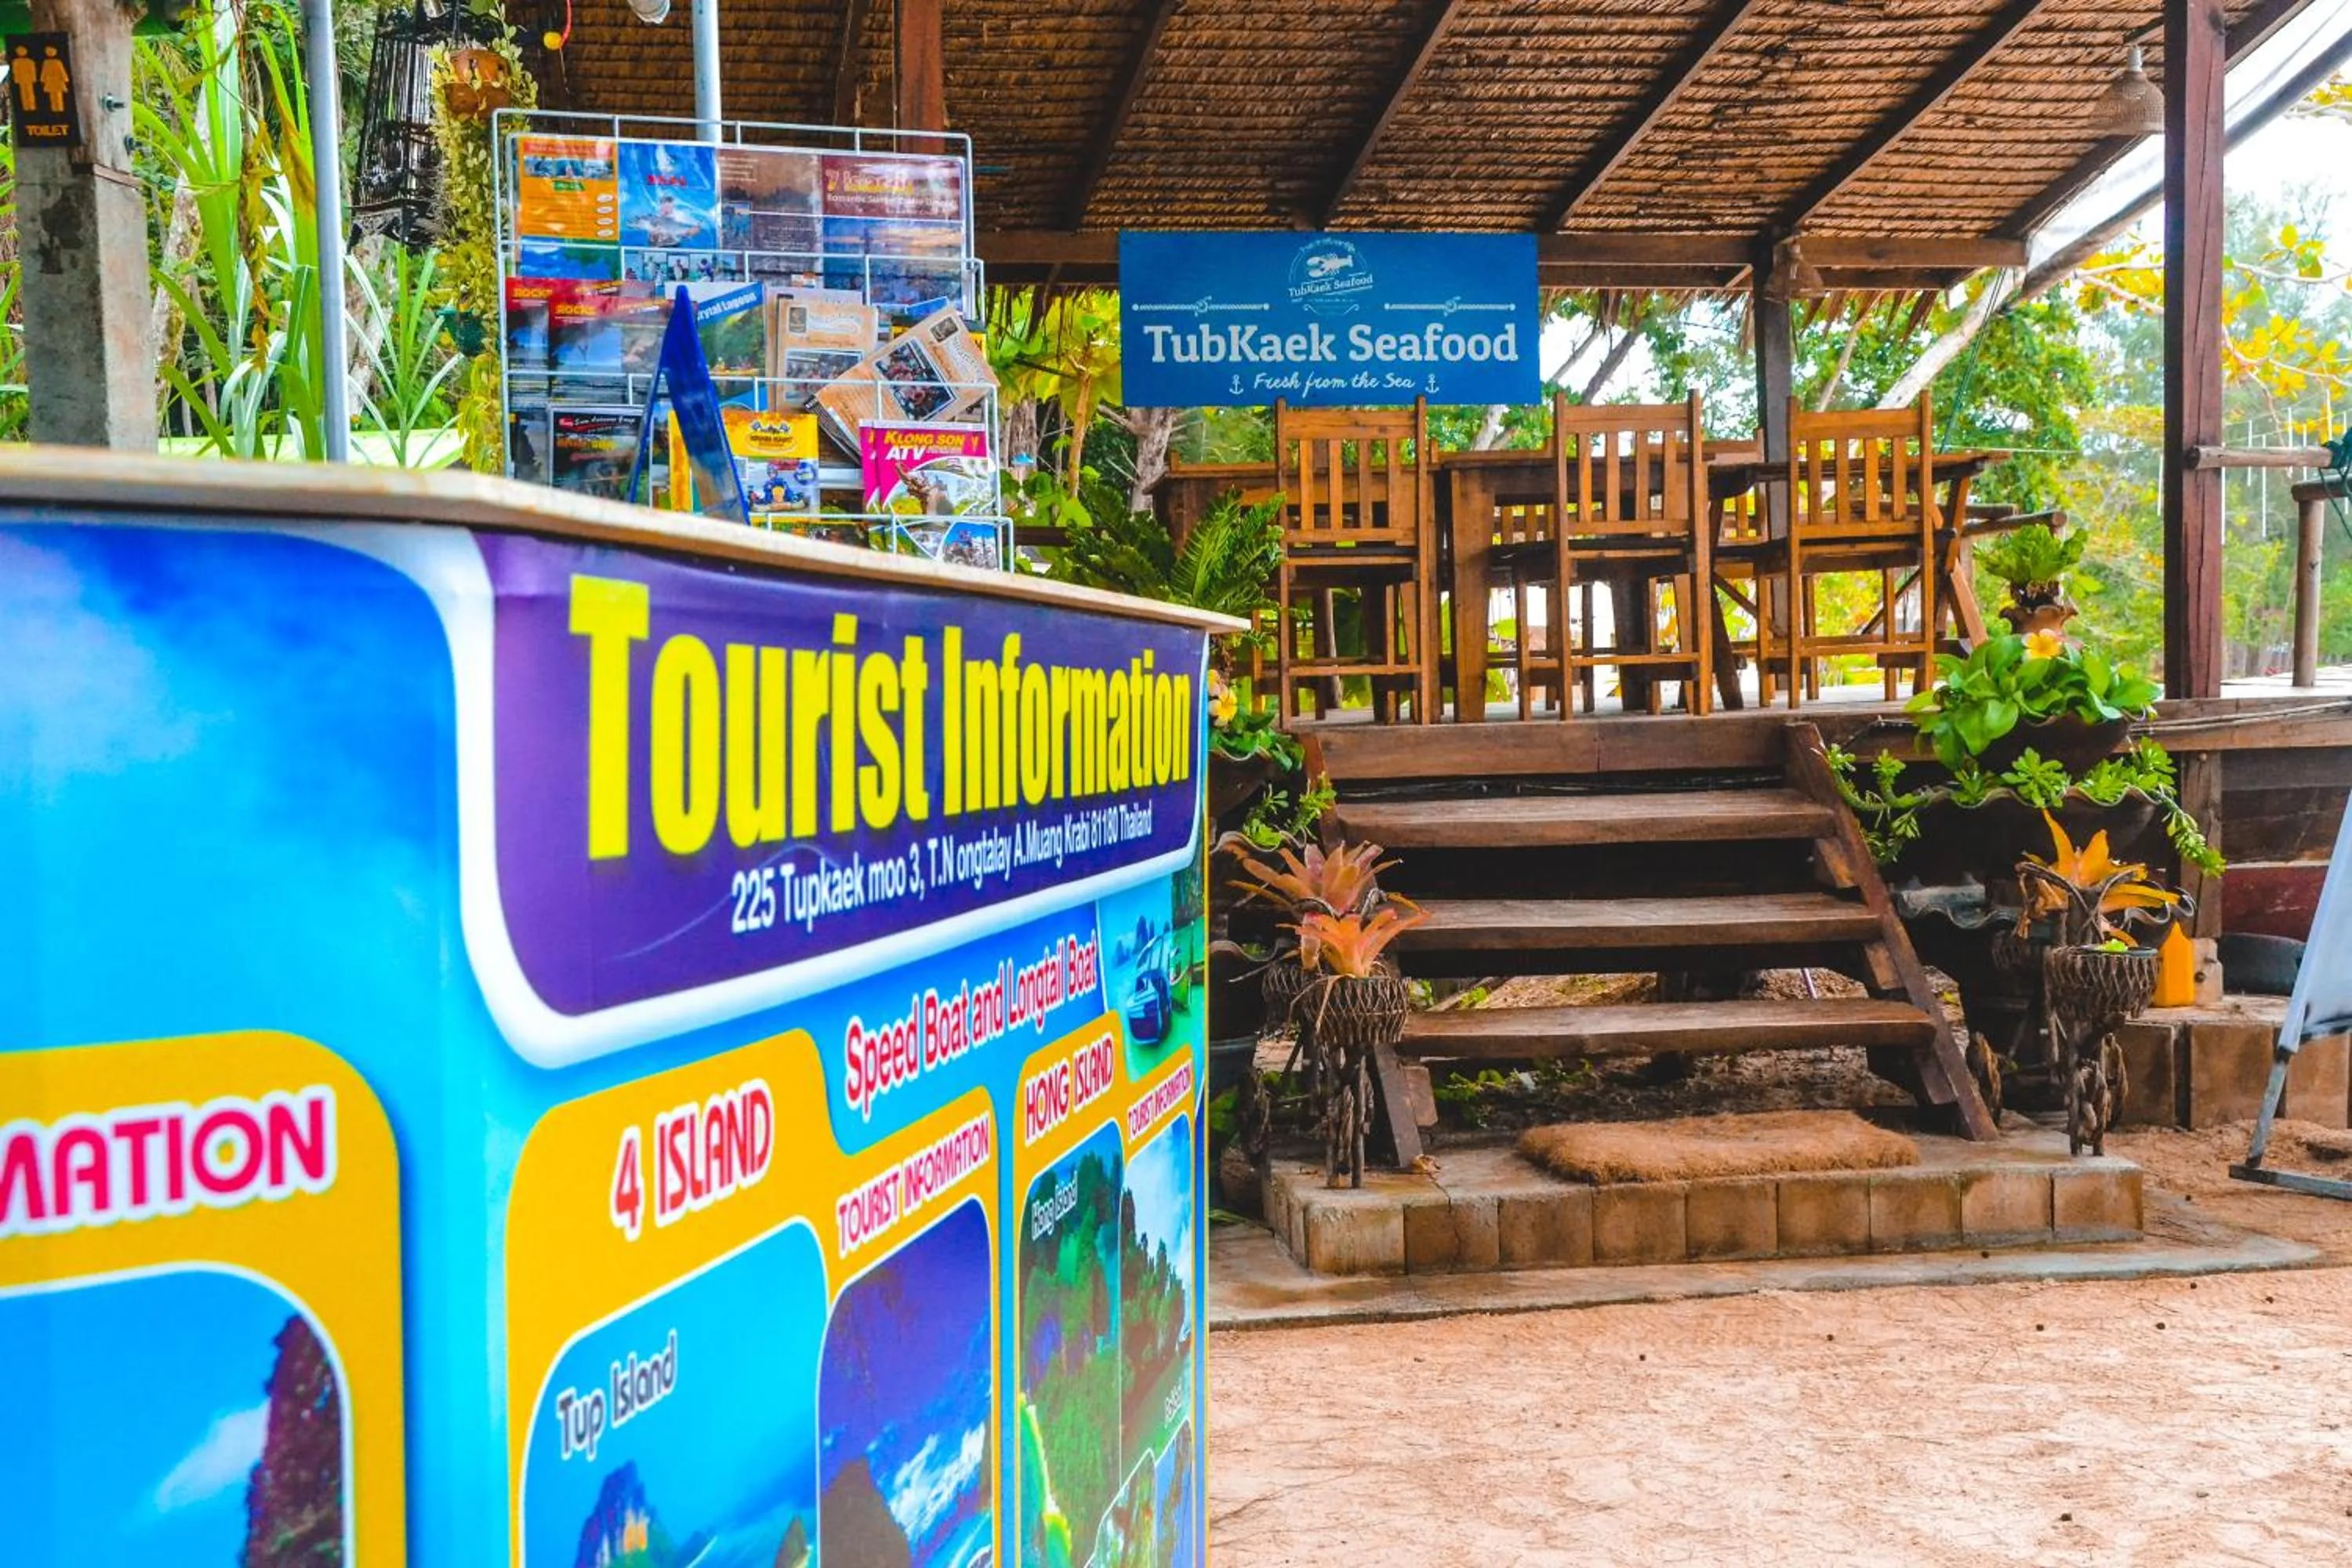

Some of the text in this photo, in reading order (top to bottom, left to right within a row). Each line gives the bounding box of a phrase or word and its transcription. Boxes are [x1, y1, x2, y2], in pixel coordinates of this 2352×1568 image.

[25, 124, 70, 136] TOILET
[1288, 273, 1373, 297] TubKaek Seafood
[1143, 322, 1519, 363] TubKaek Seafood
[1254, 370, 1416, 398] Fresh from the Sea
[884, 430, 964, 447] KLONG SON
[885, 444, 926, 460] ATV
[568, 573, 1191, 861] Tourist Information
[731, 867, 776, 934] 225
[780, 851, 864, 933] Tupkaek
[868, 855, 906, 903] moo
[909, 841, 925, 902] 3,
[1014, 819, 1062, 869] A.Muang
[1064, 811, 1090, 854] Krabi
[1119, 799, 1152, 842] Thailand
[846, 931, 1097, 1119] Speed Boat and Longtail Boat
[1025, 1035, 1113, 1142] HONG ISLAND
[614, 1086, 772, 1231] 4 ISLAND
[838, 1113, 989, 1254] TOURIST INFORMATION
[1055, 1170, 1078, 1221] Island
[557, 1331, 676, 1459] Tup Island
